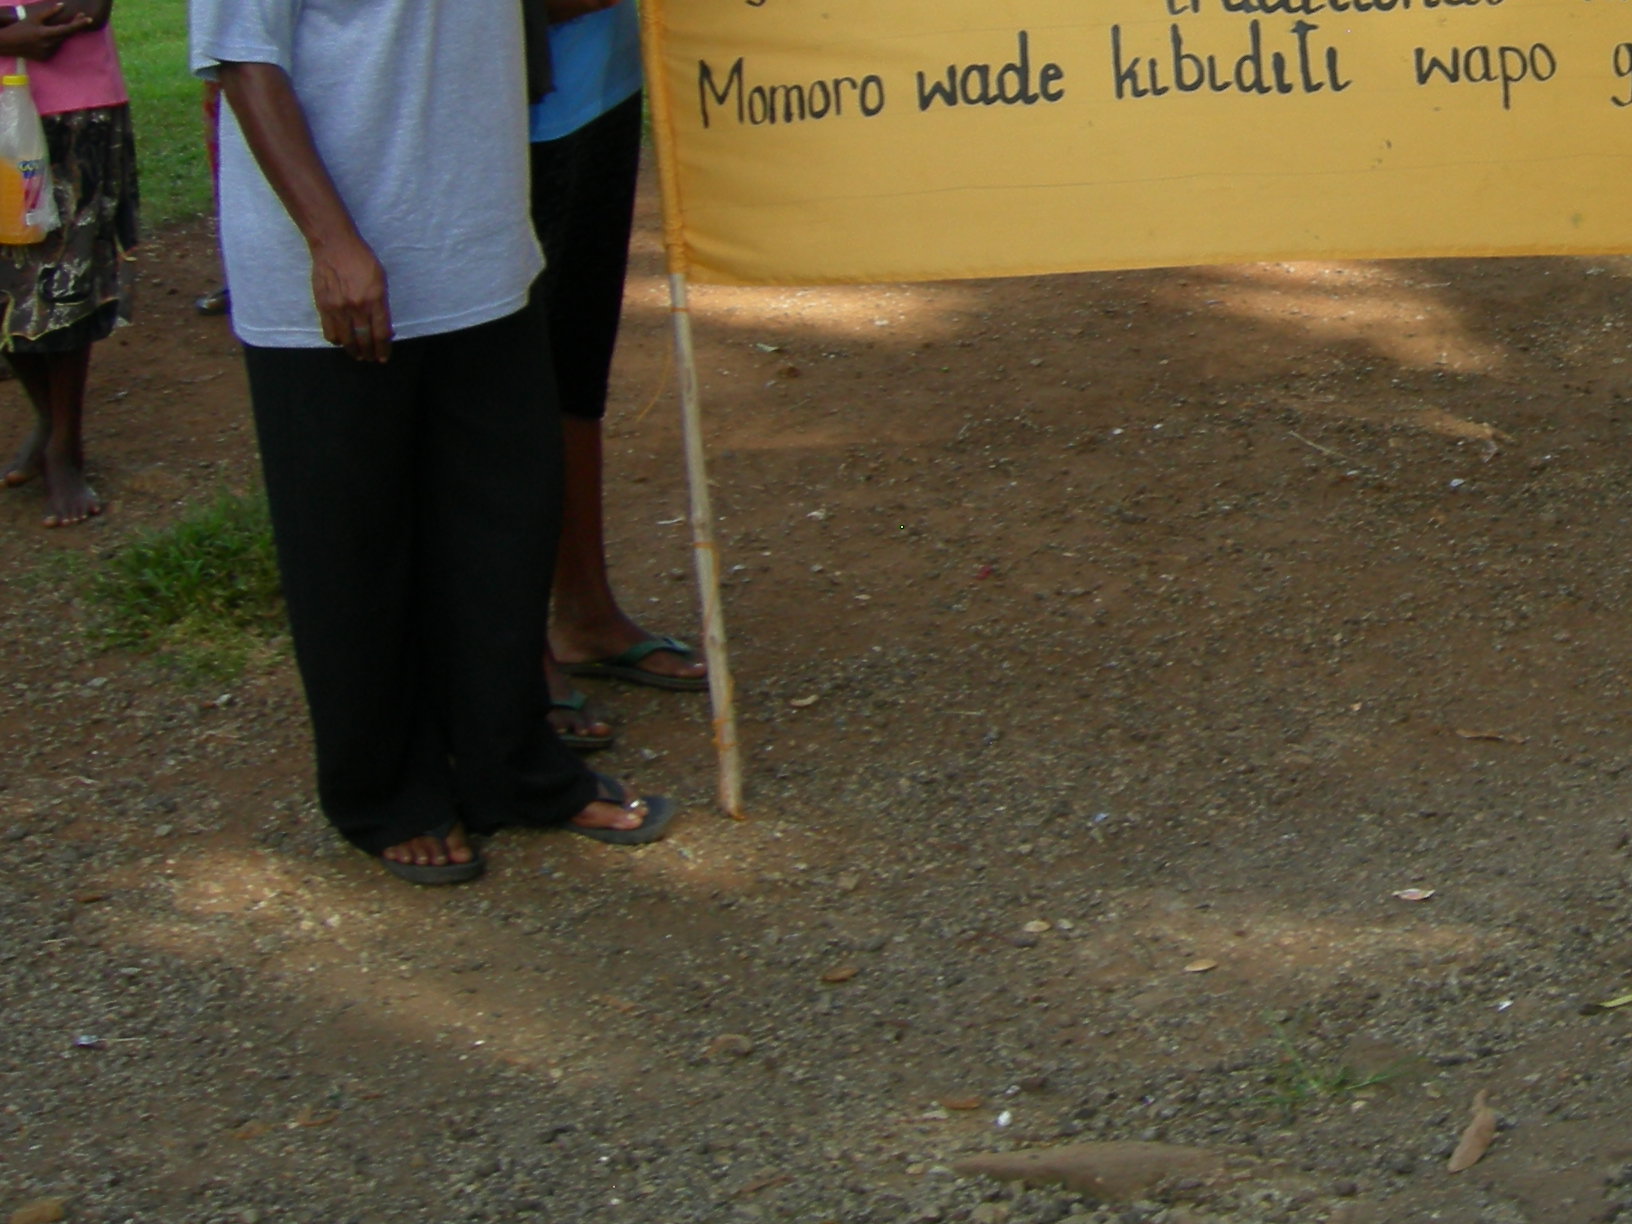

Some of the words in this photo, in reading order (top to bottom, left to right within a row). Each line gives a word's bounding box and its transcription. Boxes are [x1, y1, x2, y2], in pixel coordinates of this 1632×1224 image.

[697, 57, 886, 129] Momoro
[915, 30, 1066, 113] wade
[1413, 42, 1558, 110] wapo
